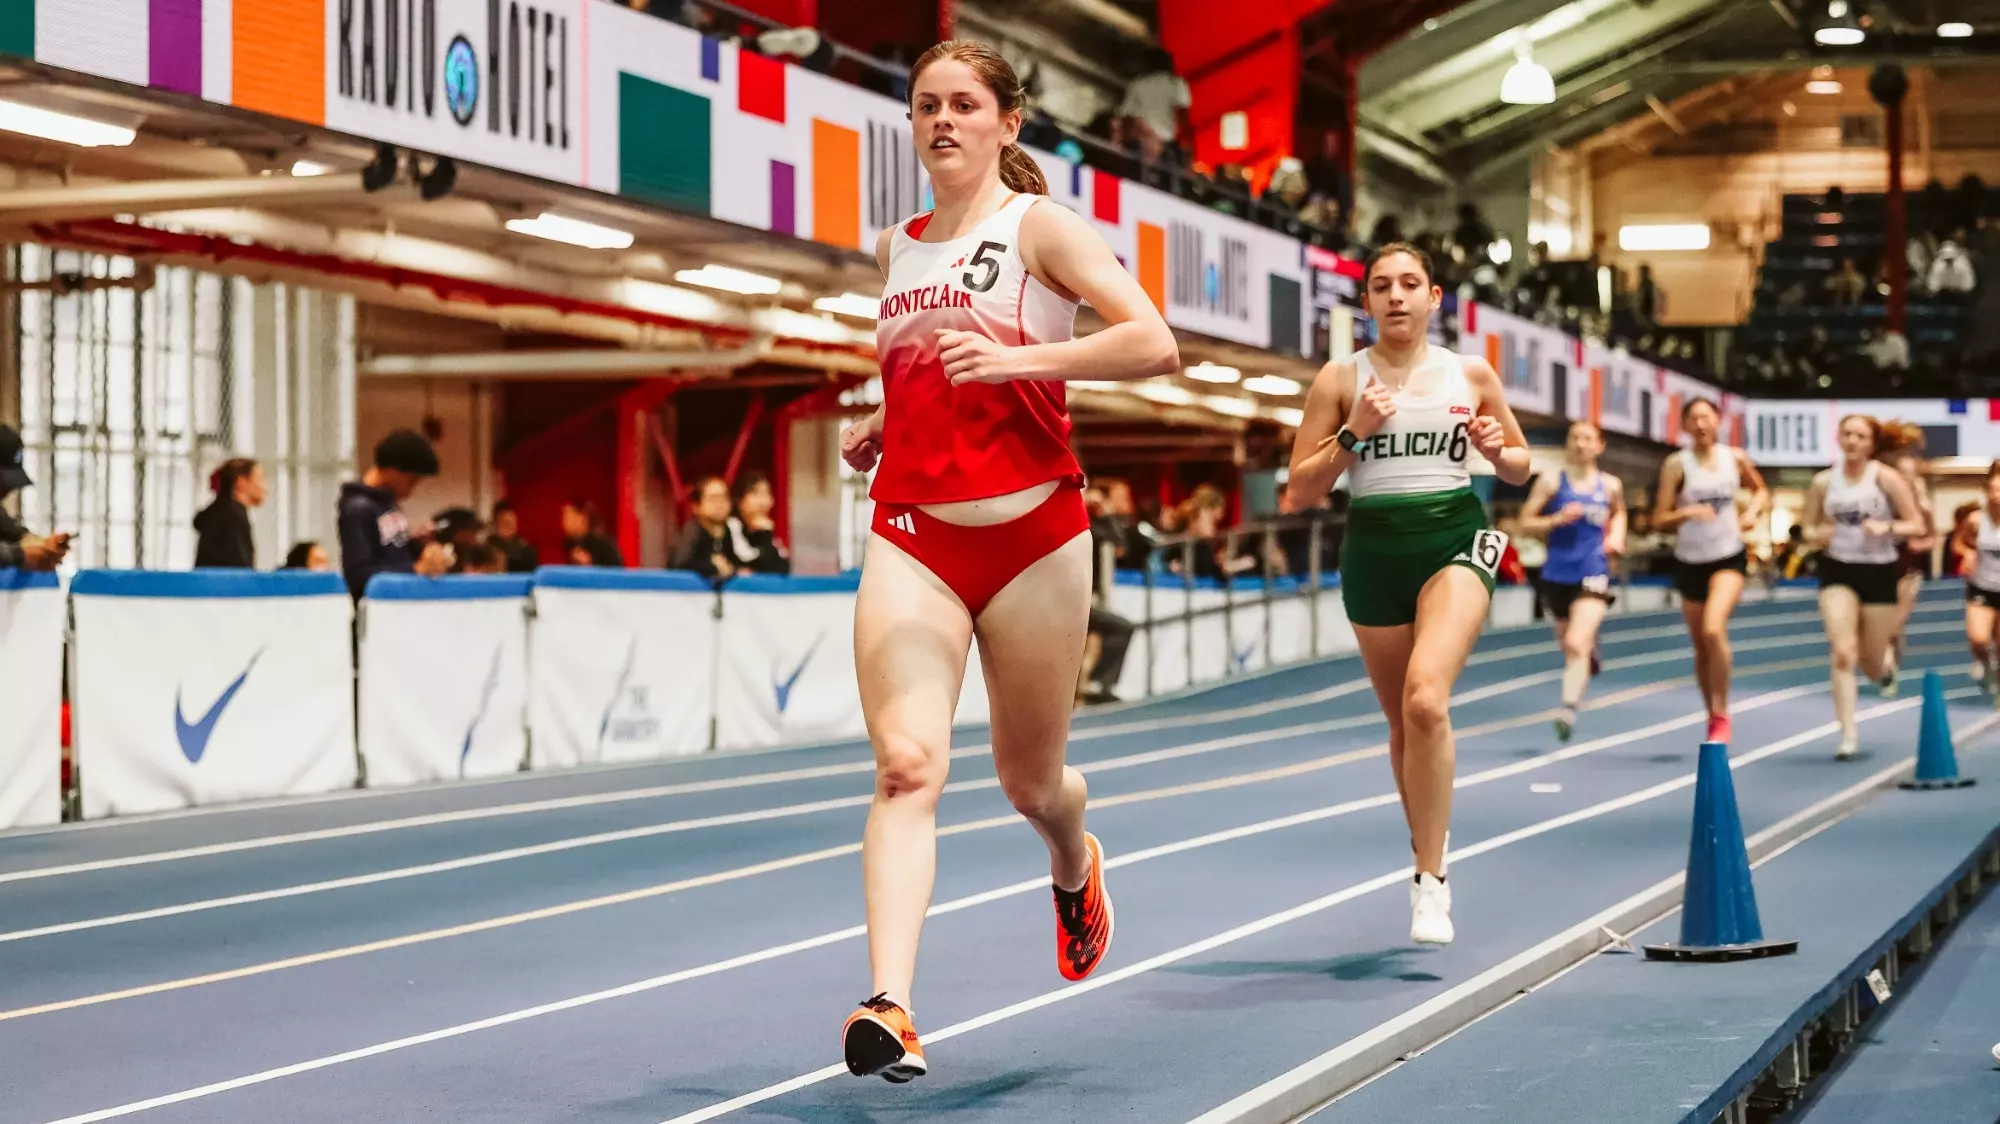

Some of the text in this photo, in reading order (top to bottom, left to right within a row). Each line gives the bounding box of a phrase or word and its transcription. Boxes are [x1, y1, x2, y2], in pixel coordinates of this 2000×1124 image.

[488, 0, 568, 149] HOTEL
[962, 240, 1007, 293] 5
[878, 283, 973, 321] MONTCLAIR
[1448, 421, 1470, 462] 6
[1478, 532, 1501, 569] 6
